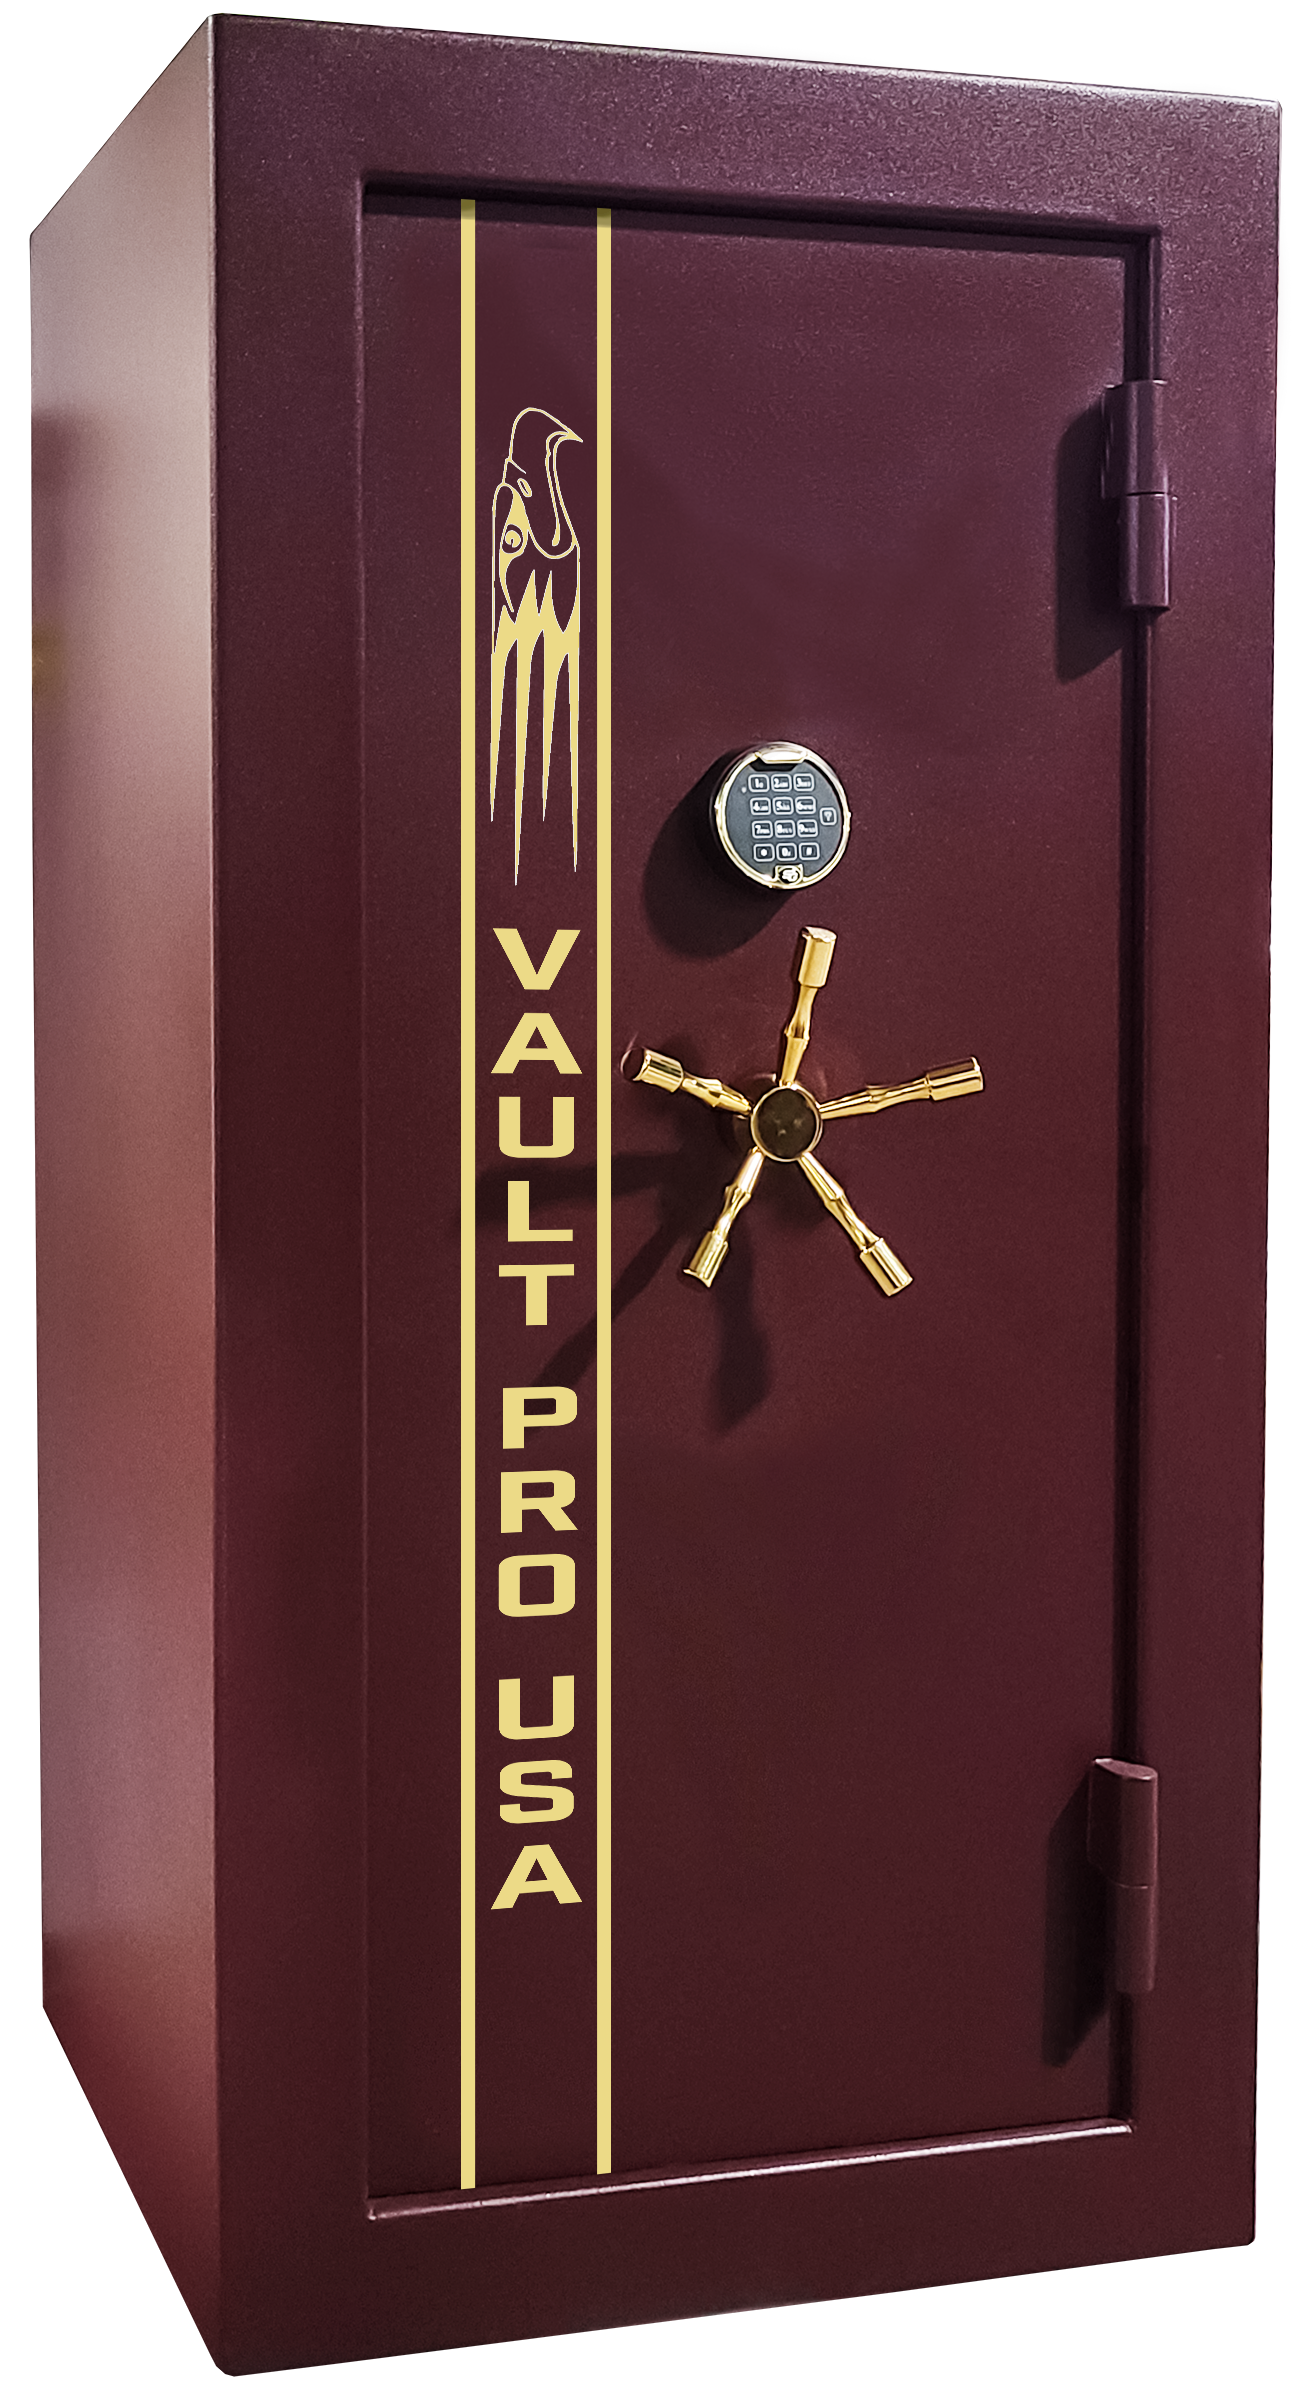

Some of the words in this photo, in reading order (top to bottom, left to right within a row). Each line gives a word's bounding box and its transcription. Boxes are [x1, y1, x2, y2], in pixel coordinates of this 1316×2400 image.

[566, 13, 674, 44] HEAVY
[491, 928, 582, 1325] VAULT
[499, 1387, 577, 1617] PRO
[491, 1676, 582, 1909] USA
